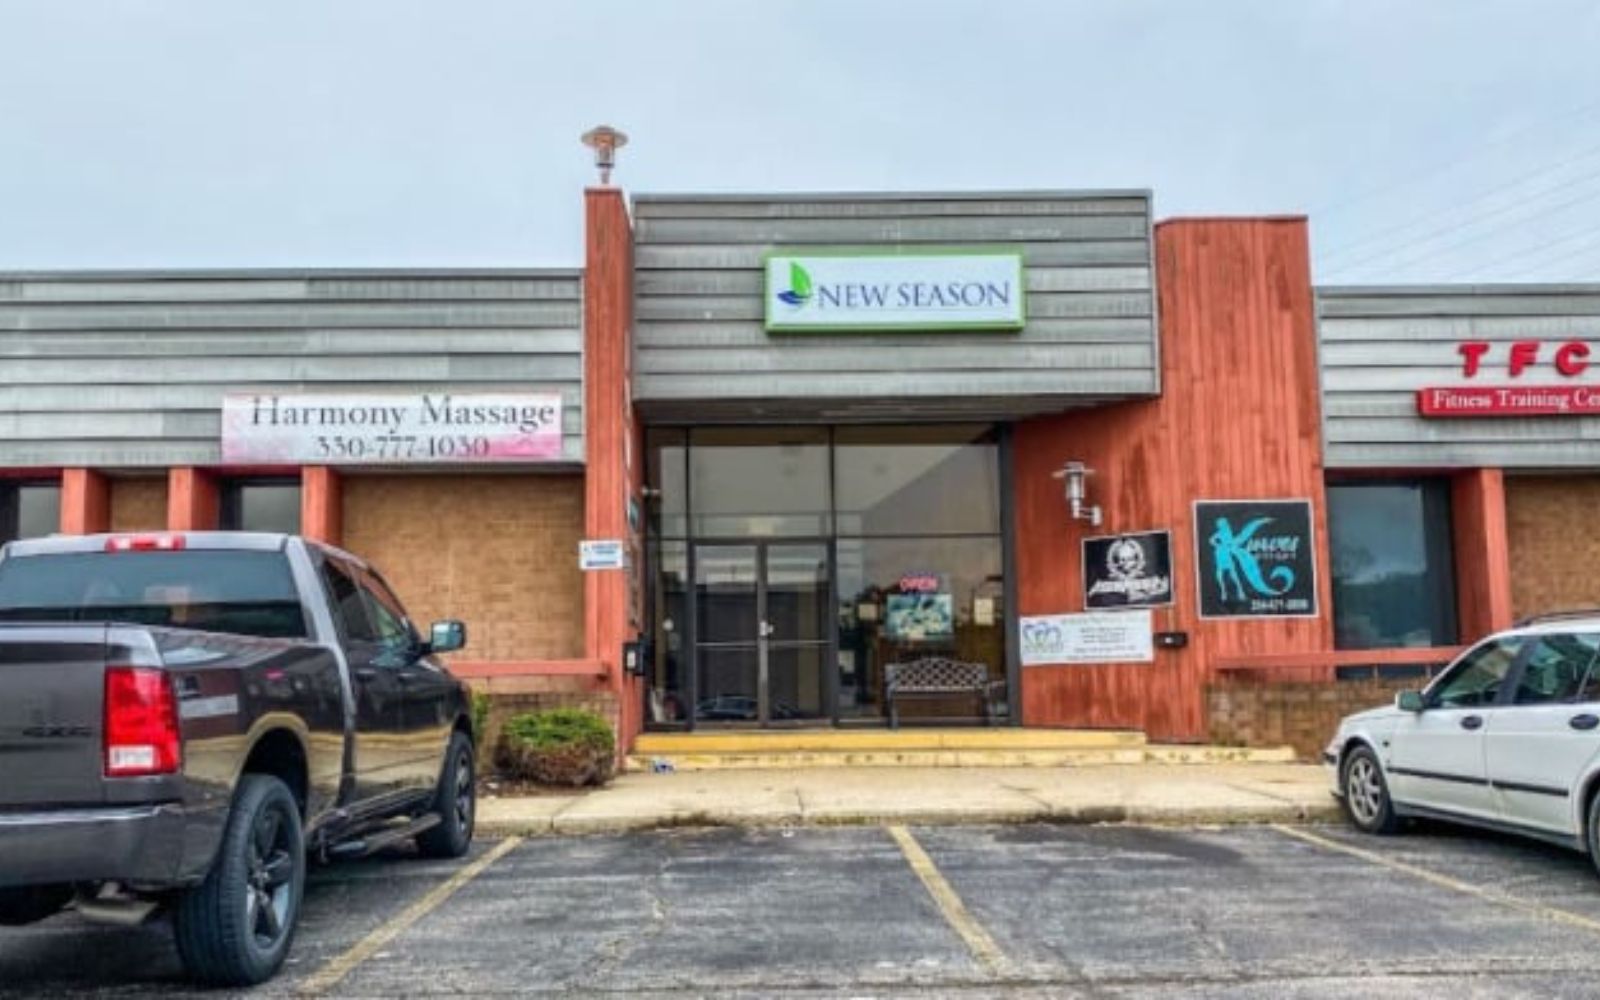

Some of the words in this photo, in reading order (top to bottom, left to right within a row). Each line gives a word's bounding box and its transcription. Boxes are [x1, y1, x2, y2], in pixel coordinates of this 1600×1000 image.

[818, 283, 889, 308] NEW
[897, 281, 1010, 307] SEASON
[1432, 389, 1492, 409] Fitness
[1496, 388, 1571, 411] Training
[251, 397, 407, 433] Harmony
[418, 395, 556, 432] Massage
[900, 576, 938, 591] OPEN
